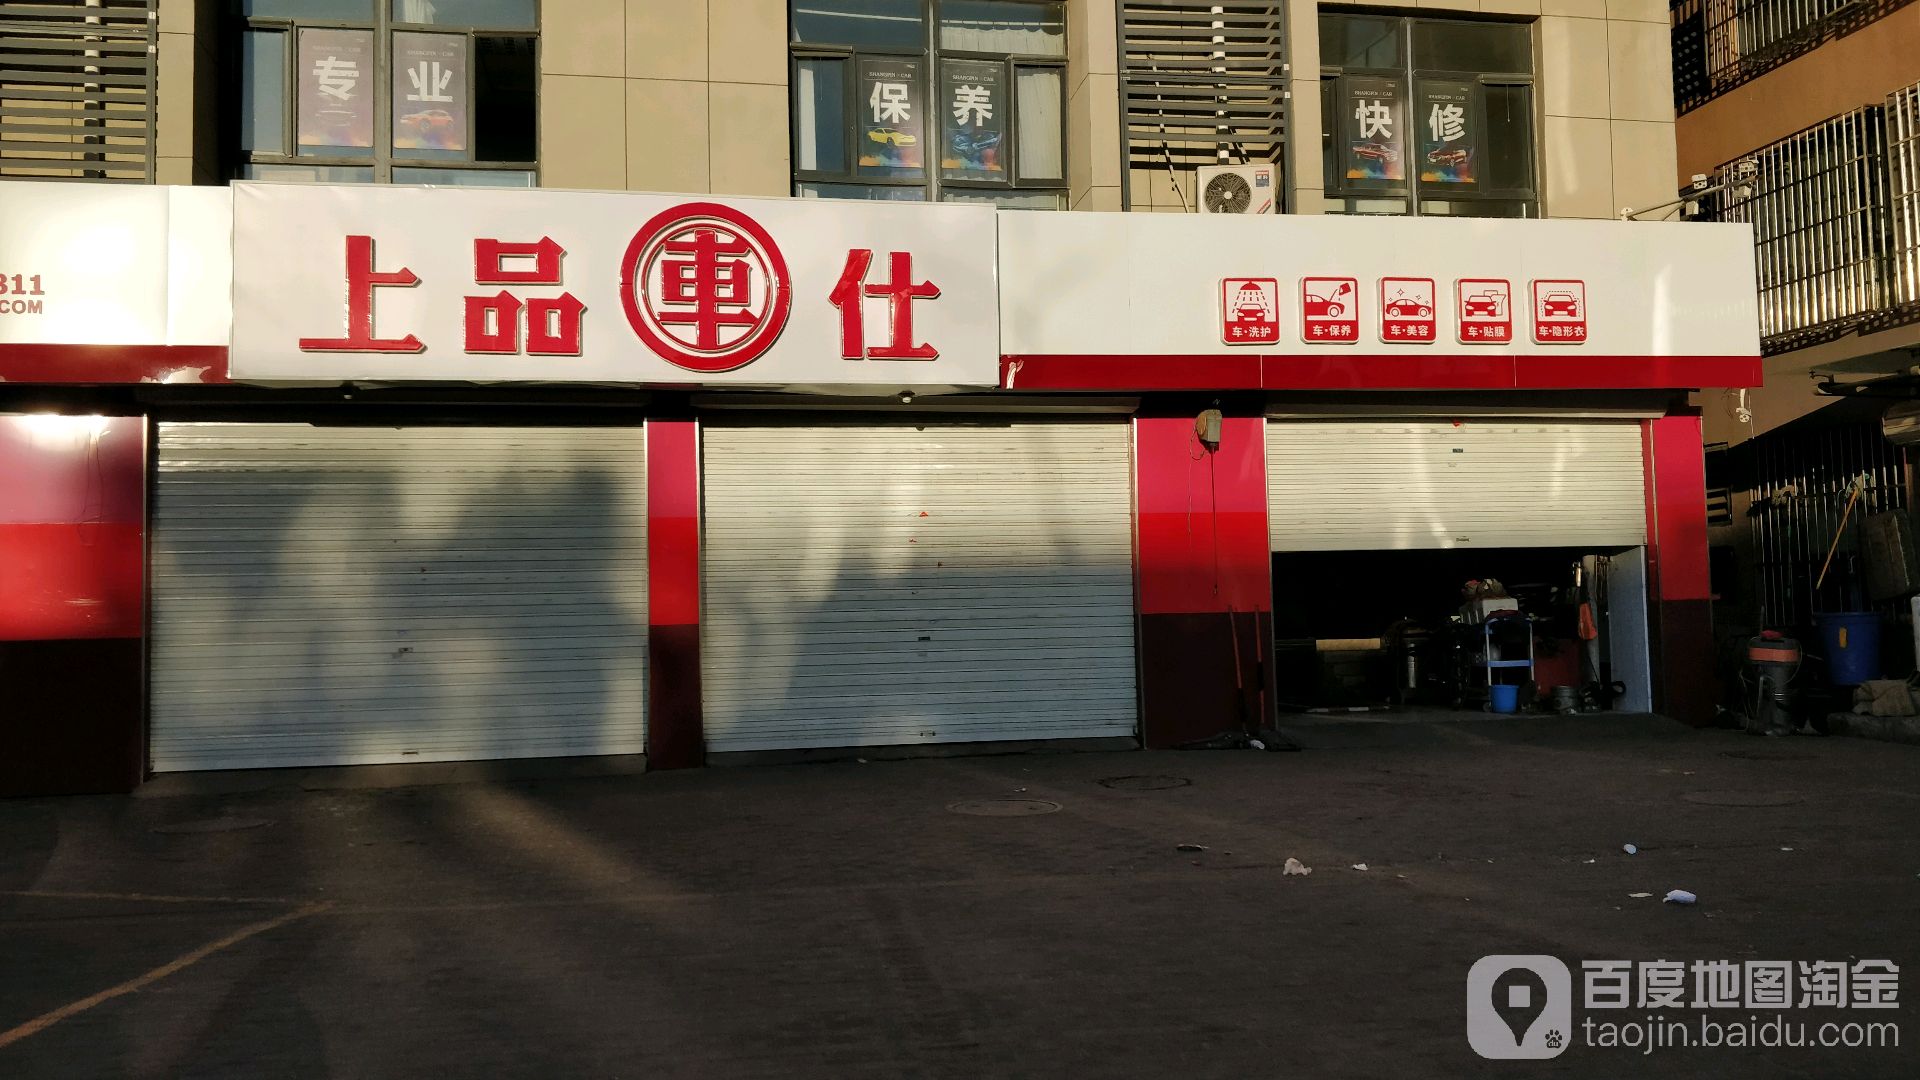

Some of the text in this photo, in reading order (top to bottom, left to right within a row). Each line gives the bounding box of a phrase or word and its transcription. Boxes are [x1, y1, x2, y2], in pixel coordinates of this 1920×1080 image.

[313, 56, 360, 101] 专
[407, 61, 454, 102] 业
[870, 82, 911, 124] 保
[953, 85, 993, 127] 养
[1355, 99, 1393, 139] 快
[1429, 103, 1466, 142] 修
[299, 229, 941, 361] 上品車仕
